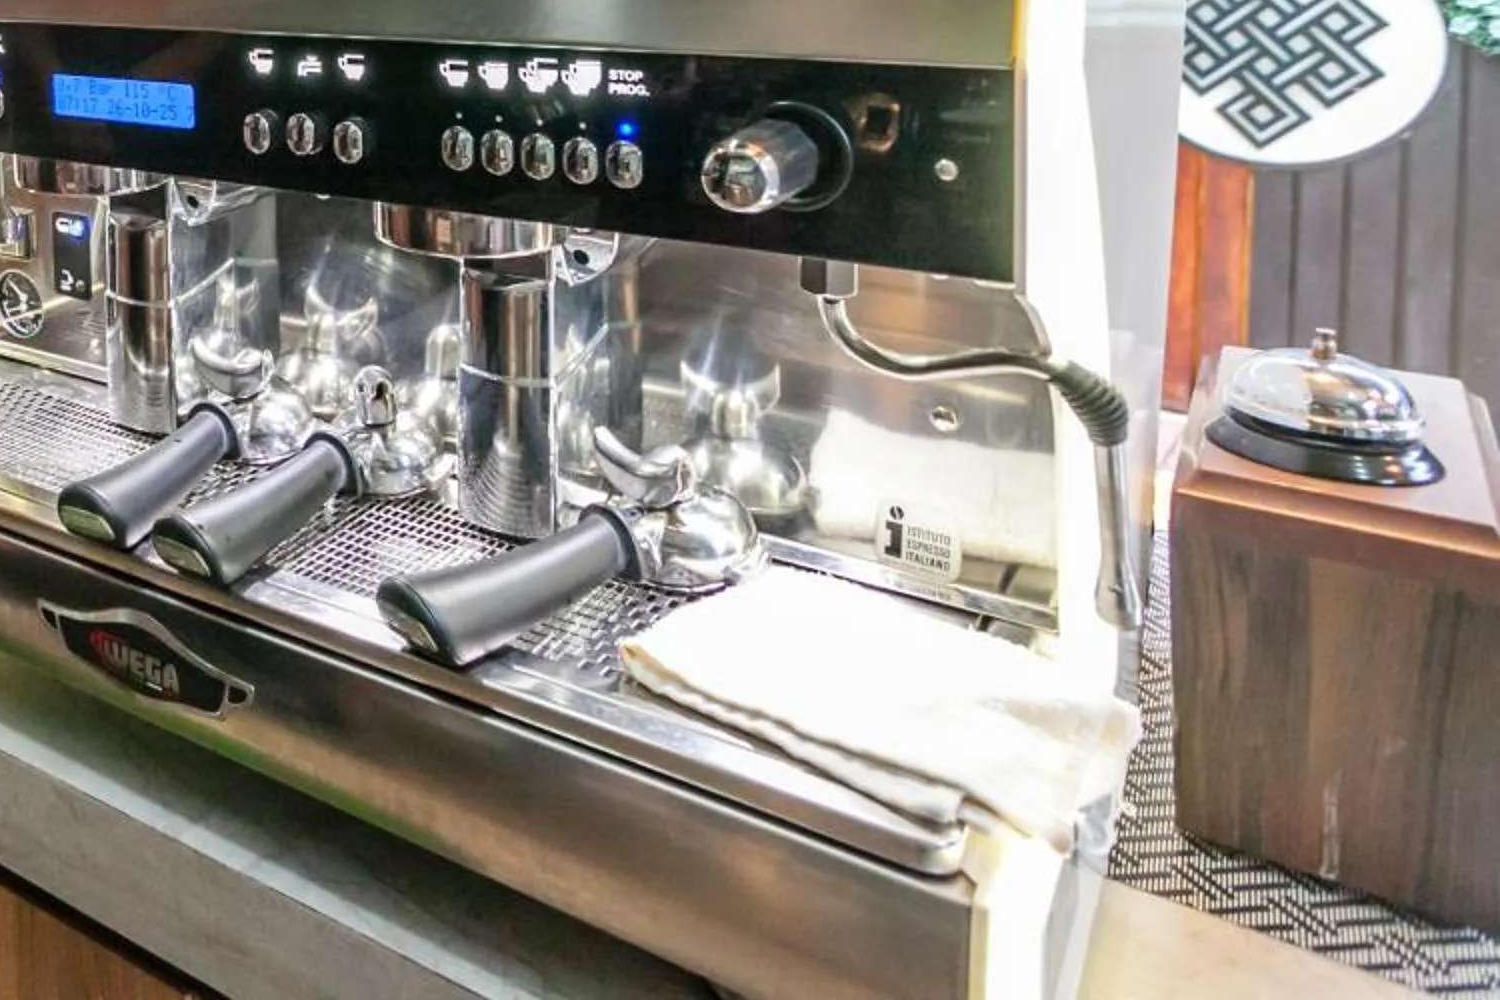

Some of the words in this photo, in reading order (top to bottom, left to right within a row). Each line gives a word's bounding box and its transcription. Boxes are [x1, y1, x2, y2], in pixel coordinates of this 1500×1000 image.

[608, 69, 643, 81] STOP
[124, 82, 150, 99] 115
[608, 83, 650, 97] PROG.
[907, 526, 951, 546] ISTITUTO
[907, 539, 951, 559] ESPRESSO
[905, 551, 950, 571] ITALIANO
[100, 639, 180, 695] WEGA
